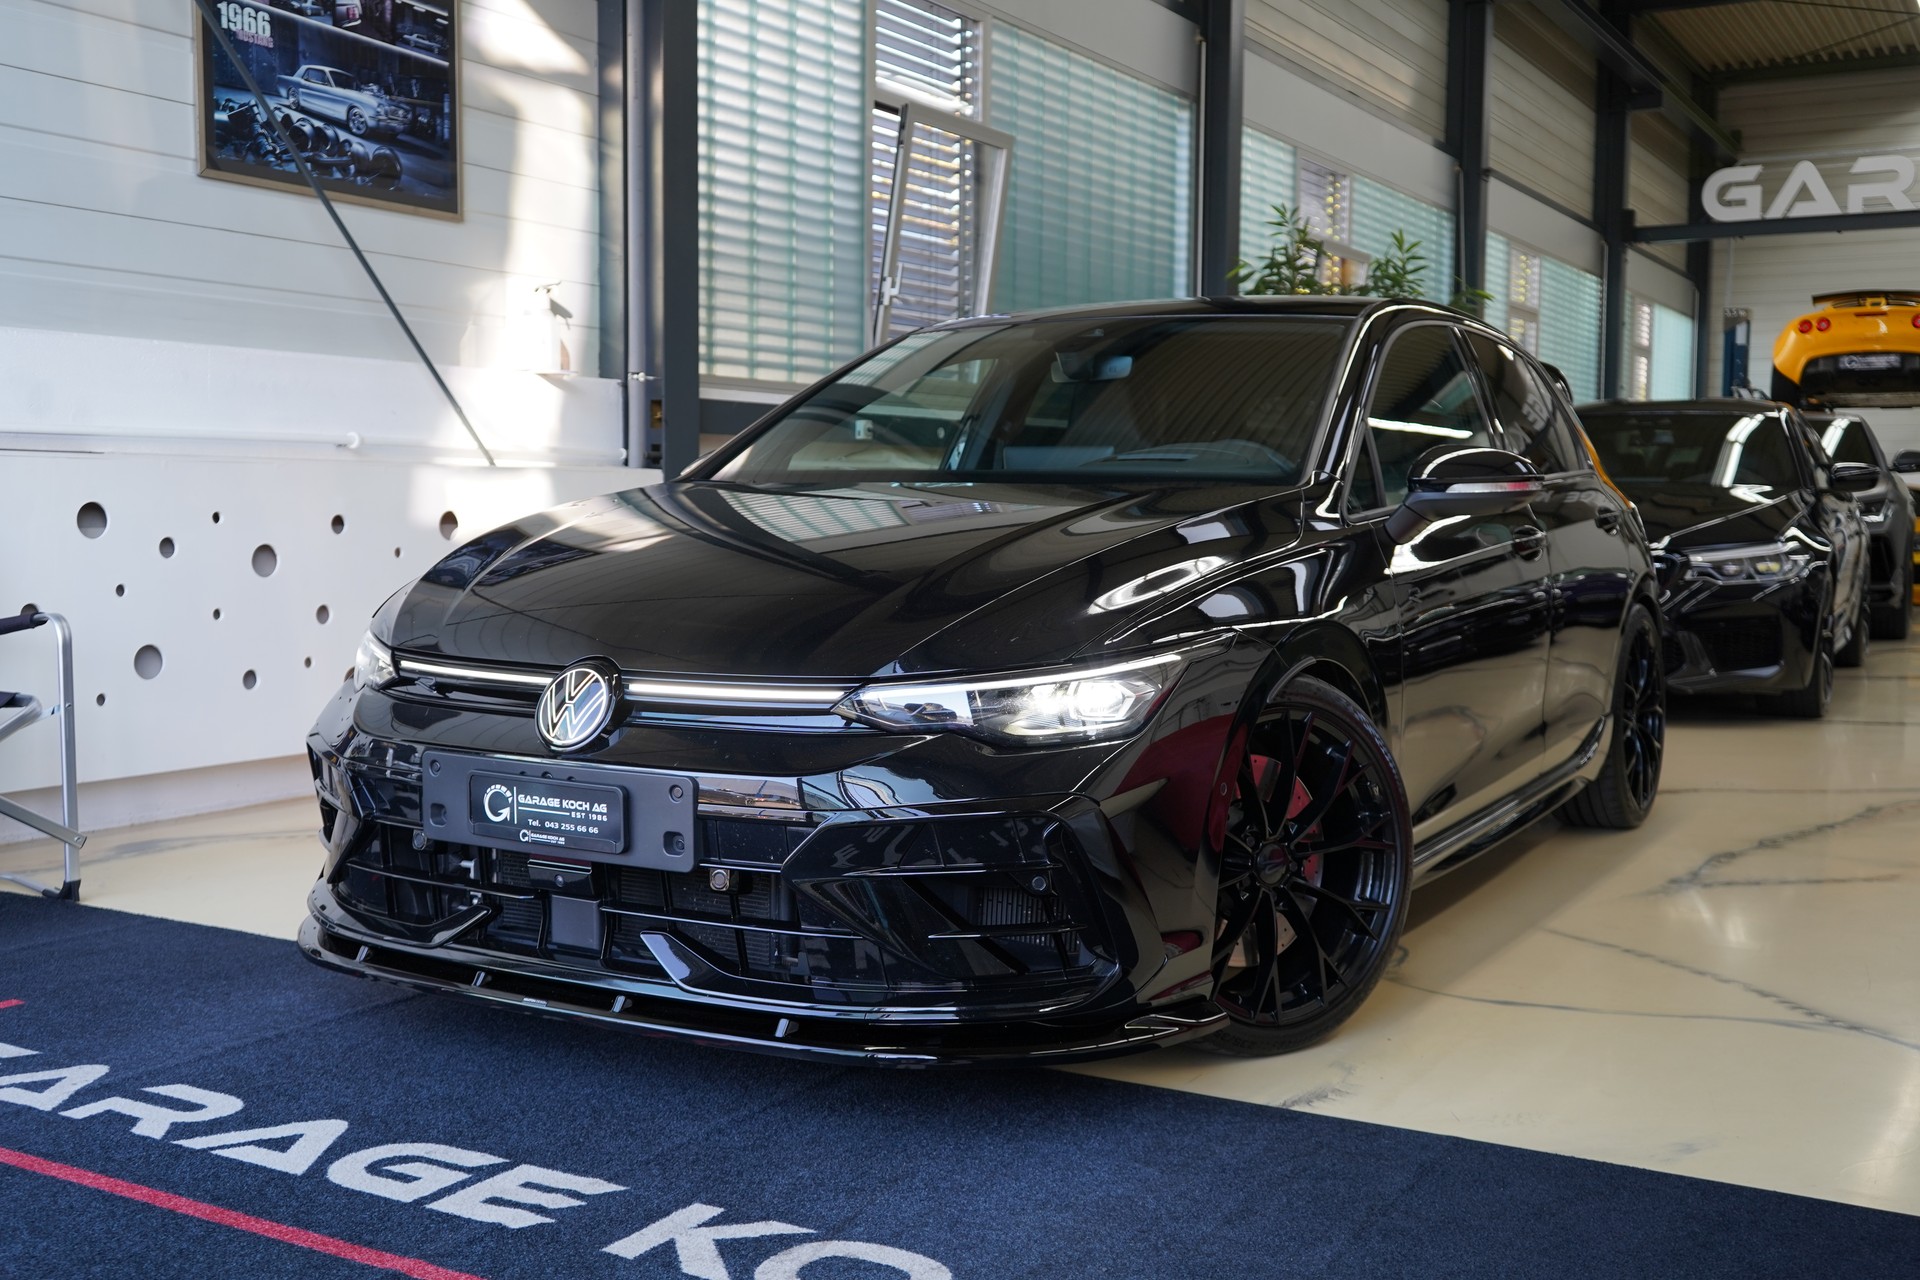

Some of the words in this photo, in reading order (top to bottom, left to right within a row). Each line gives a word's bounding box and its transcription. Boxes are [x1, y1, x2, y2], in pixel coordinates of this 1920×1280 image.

[217, 1, 271, 37] 1966
[234, 28, 274, 48] MUSTANG
[1701, 154, 1920, 222] GAR
[518, 794, 560, 807] GARAGE
[562, 799, 590, 811] KOCH
[592, 803, 608, 813] AG
[528, 819, 541, 827] Tel.
[544, 821, 559, 829] 043
[561, 823, 575, 831] 255
[577, 825, 587, 833] 66
[588, 826, 599, 834] 66
[571, 811, 586, 819] EST
[588, 813, 608, 822] 1986
[0, 1042, 630, 1229] ARAGE
